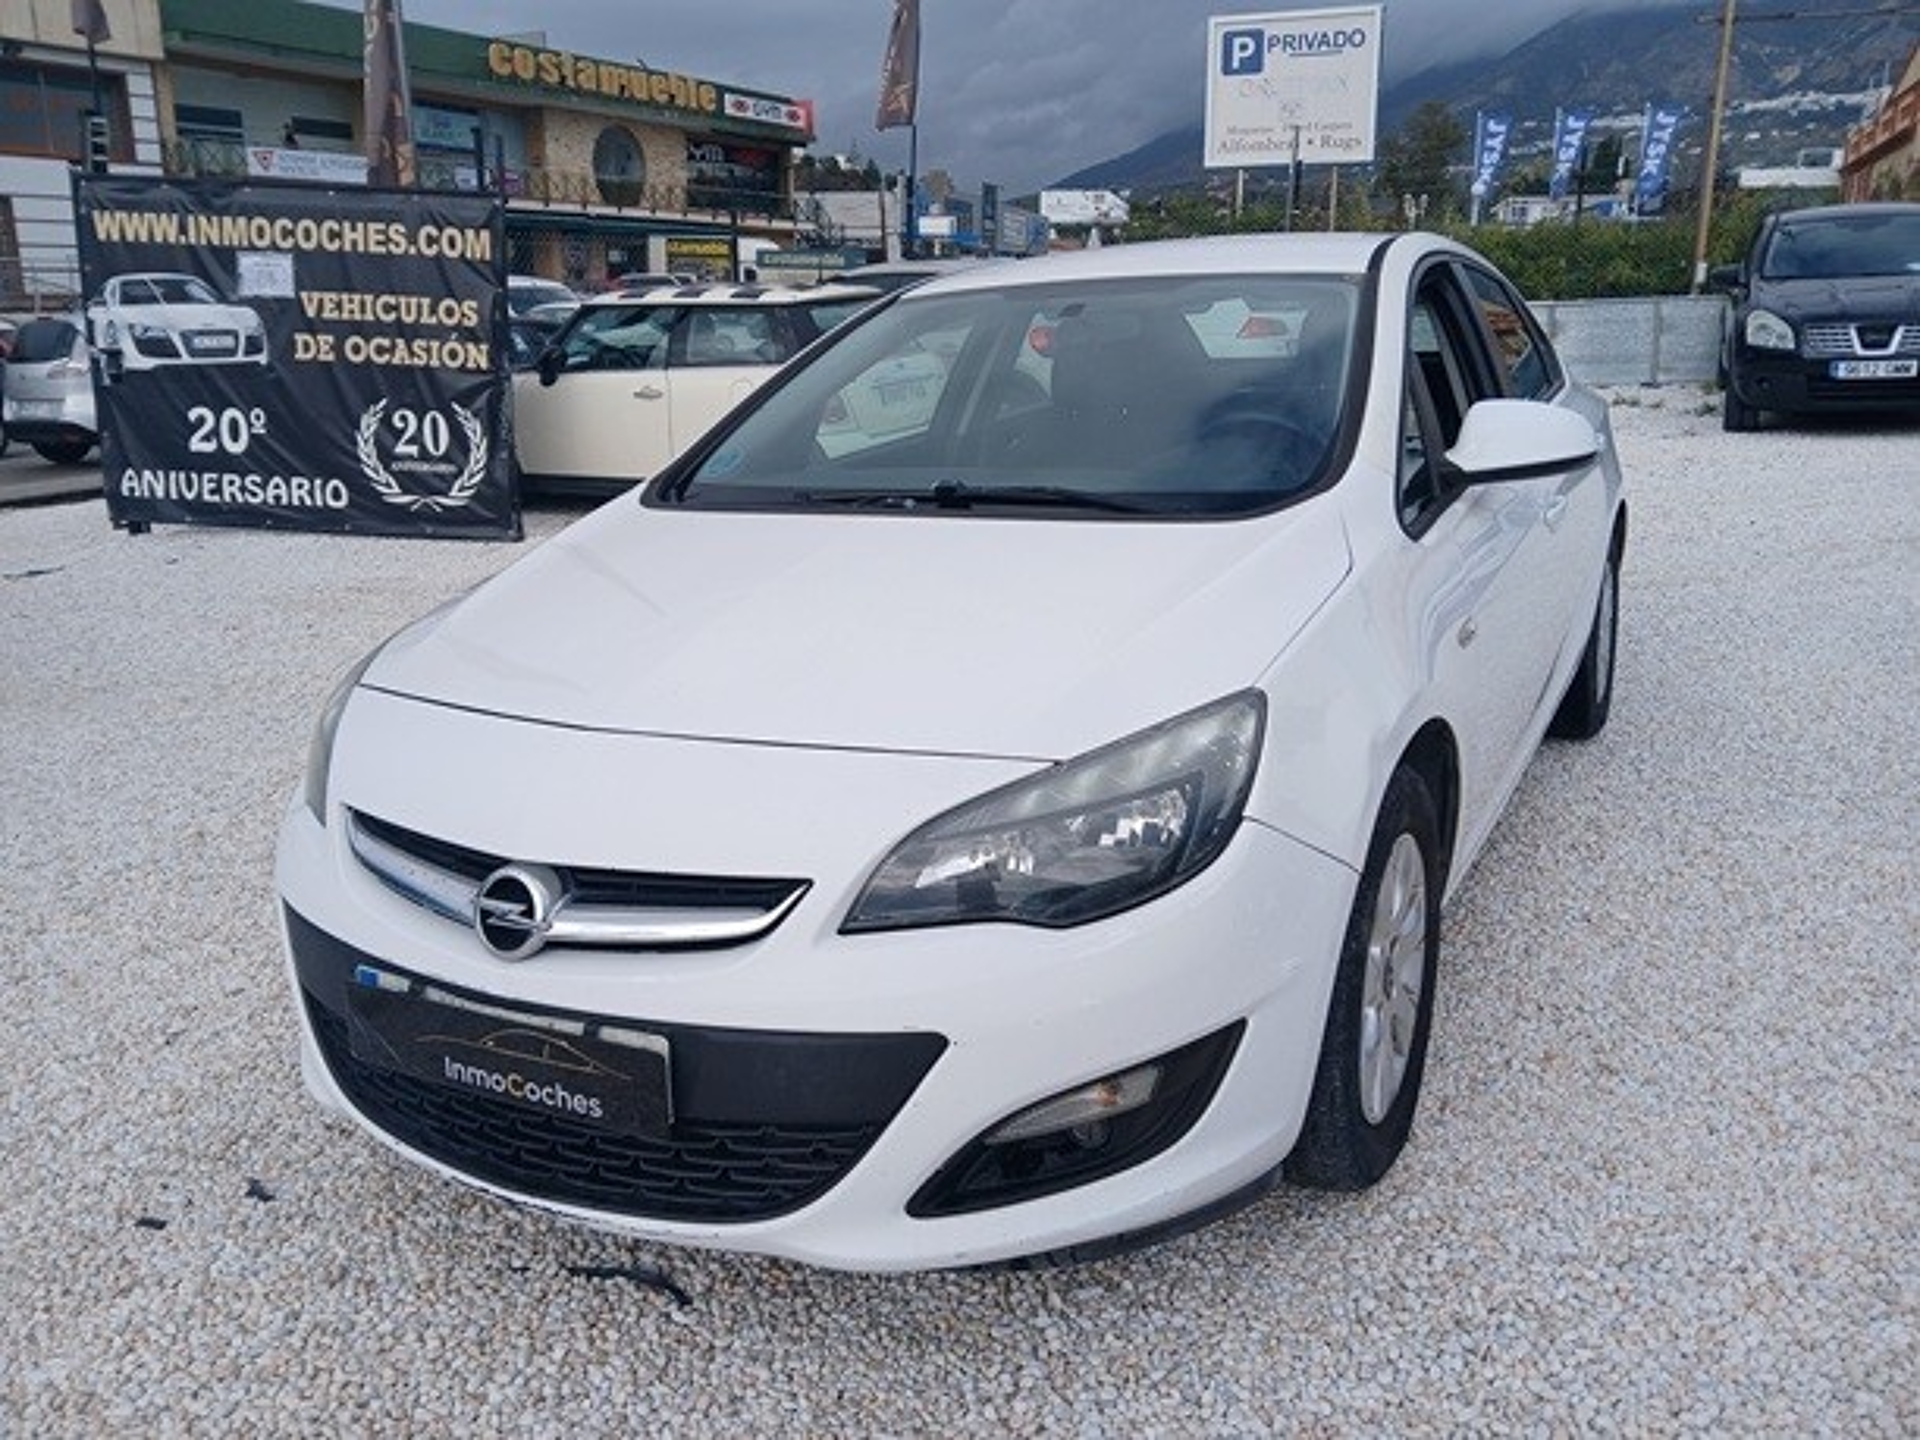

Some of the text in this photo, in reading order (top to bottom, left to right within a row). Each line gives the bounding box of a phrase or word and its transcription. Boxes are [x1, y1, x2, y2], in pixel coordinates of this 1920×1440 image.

[1232, 28, 1366, 69] P PRIVADO
[1217, 134, 1362, 155] Alfombra Rugs
[1480, 118, 1507, 182] JYSK
[1553, 115, 1587, 180] JYSK
[1639, 110, 1678, 177] JYSK
[93, 209, 492, 262] WWW.INMOCOCHES.COM
[300, 291, 479, 328] VEHICULOS
[294, 331, 489, 371] DE OCASIÓN
[392, 409, 451, 457] 20
[120, 467, 350, 510] ANIVERSARIO
[444, 1055, 604, 1119] InmoCoches
